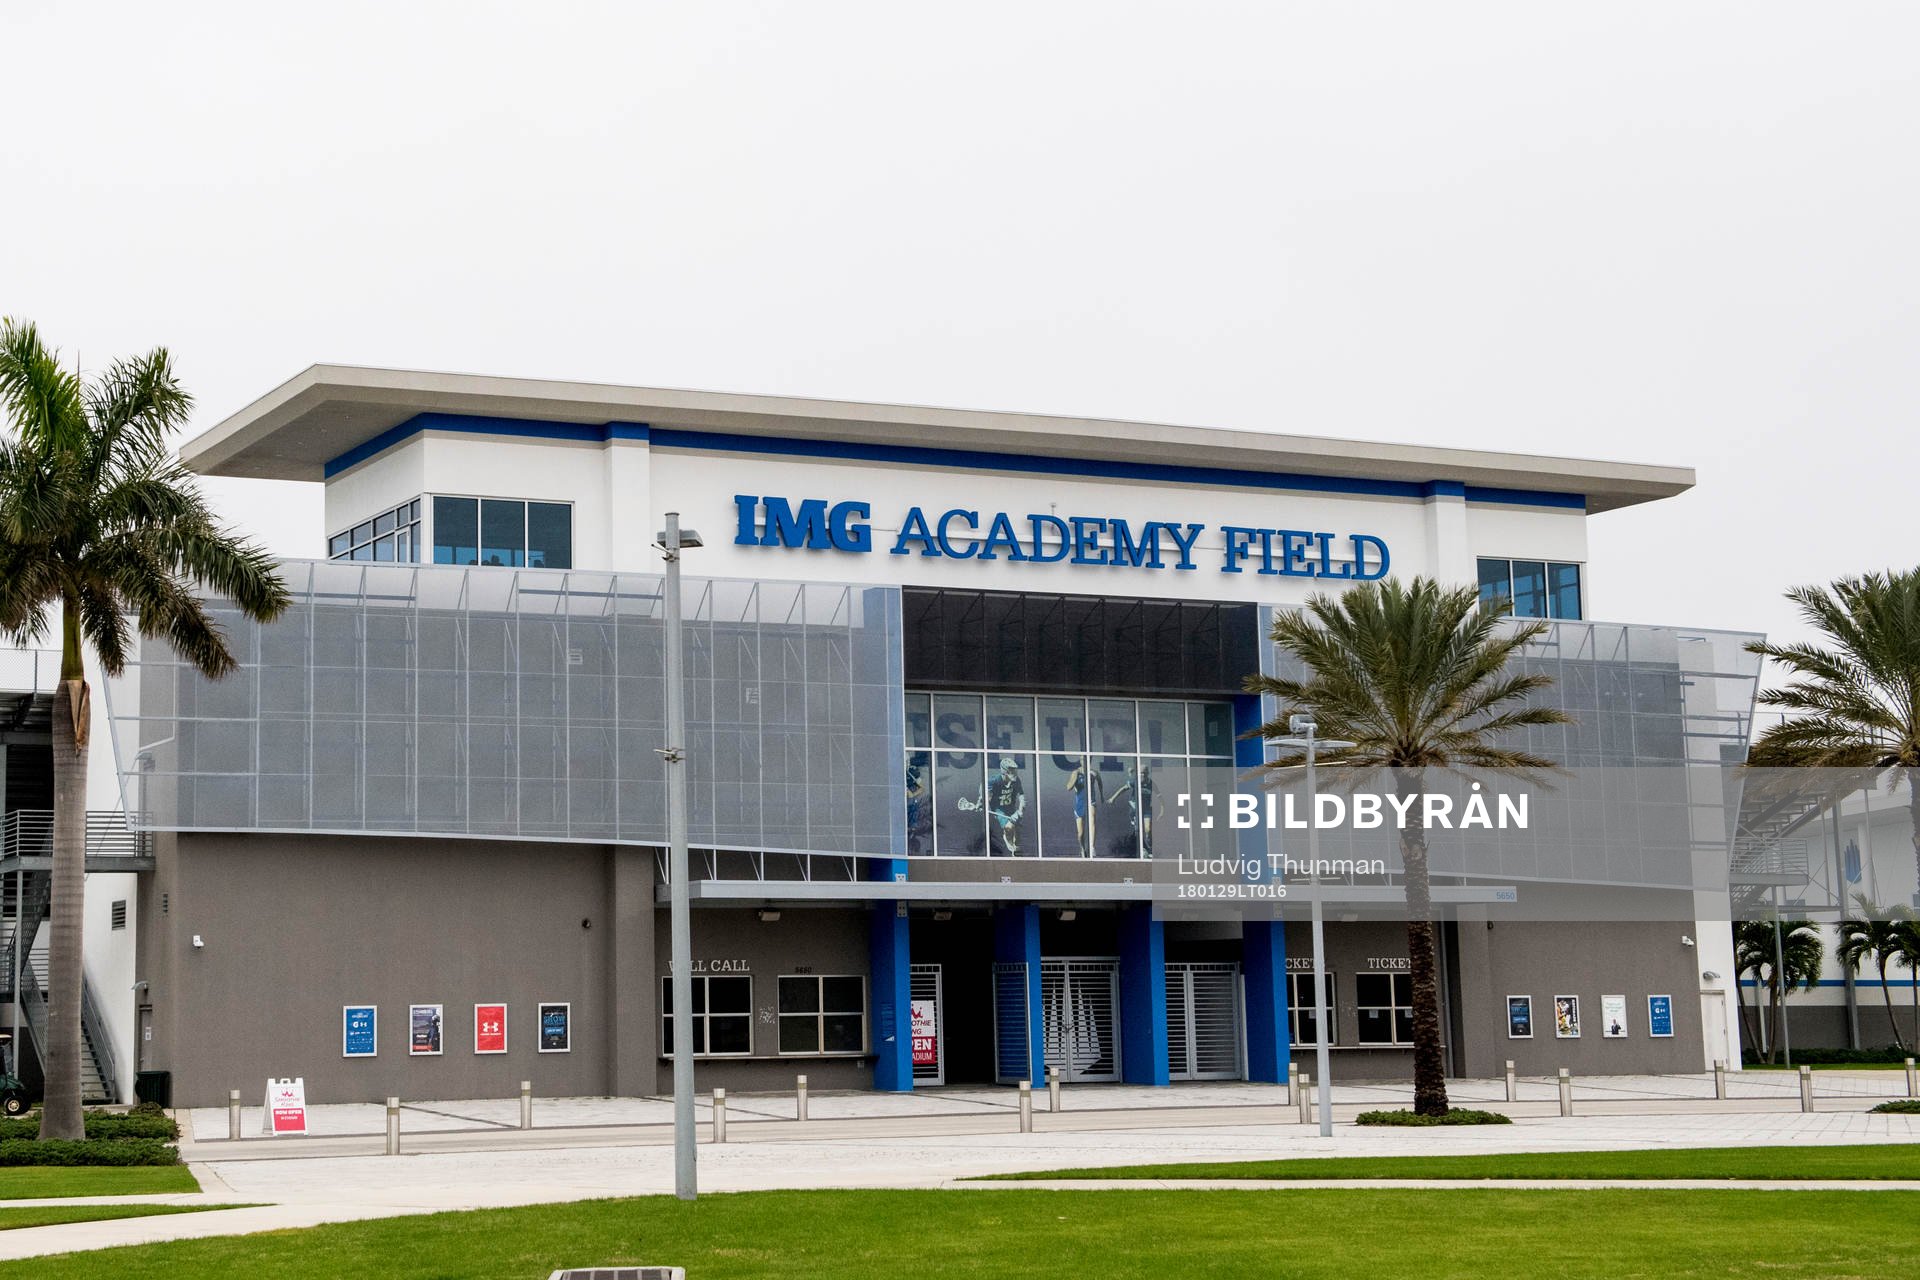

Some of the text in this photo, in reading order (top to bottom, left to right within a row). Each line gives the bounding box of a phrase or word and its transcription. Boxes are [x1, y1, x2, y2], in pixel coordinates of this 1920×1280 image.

[734, 495, 1390, 580] IMG ACADEMY FIELD
[1496, 891, 1515, 900] 5650
[710, 959, 750, 972] CALL
[912, 1038, 932, 1050] EN
